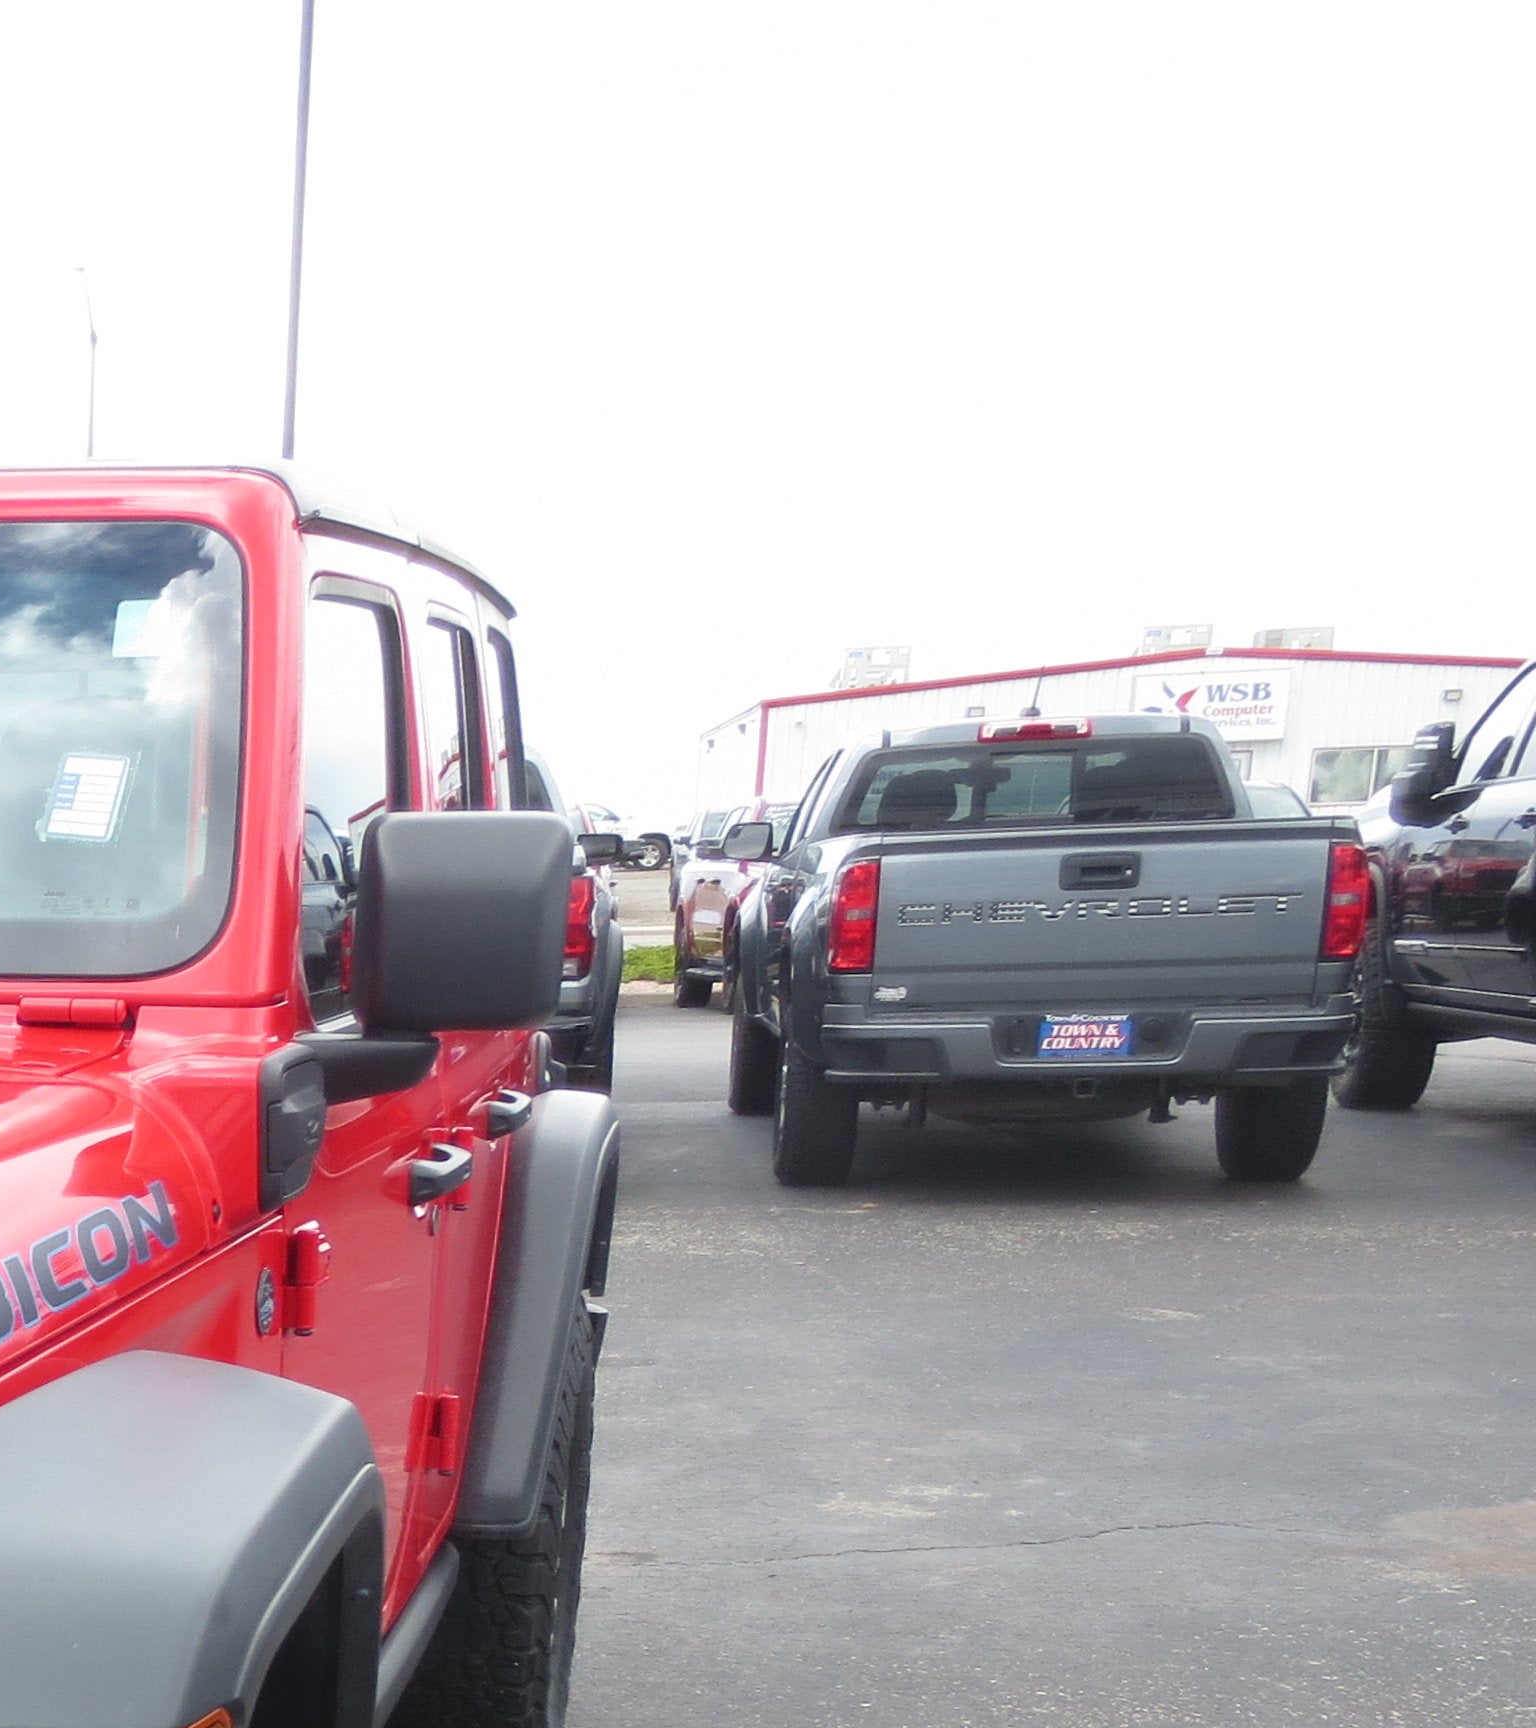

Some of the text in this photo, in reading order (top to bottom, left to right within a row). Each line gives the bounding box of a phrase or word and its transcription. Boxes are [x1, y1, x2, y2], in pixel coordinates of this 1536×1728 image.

[1205, 682, 1272, 703] WSB
[1202, 704, 1274, 718] Computer
[898, 893, 1303, 926] CHEVROLET
[1051, 1023, 1119, 1036] TOWN &
[1041, 1036, 1126, 1050] COUNTRY
